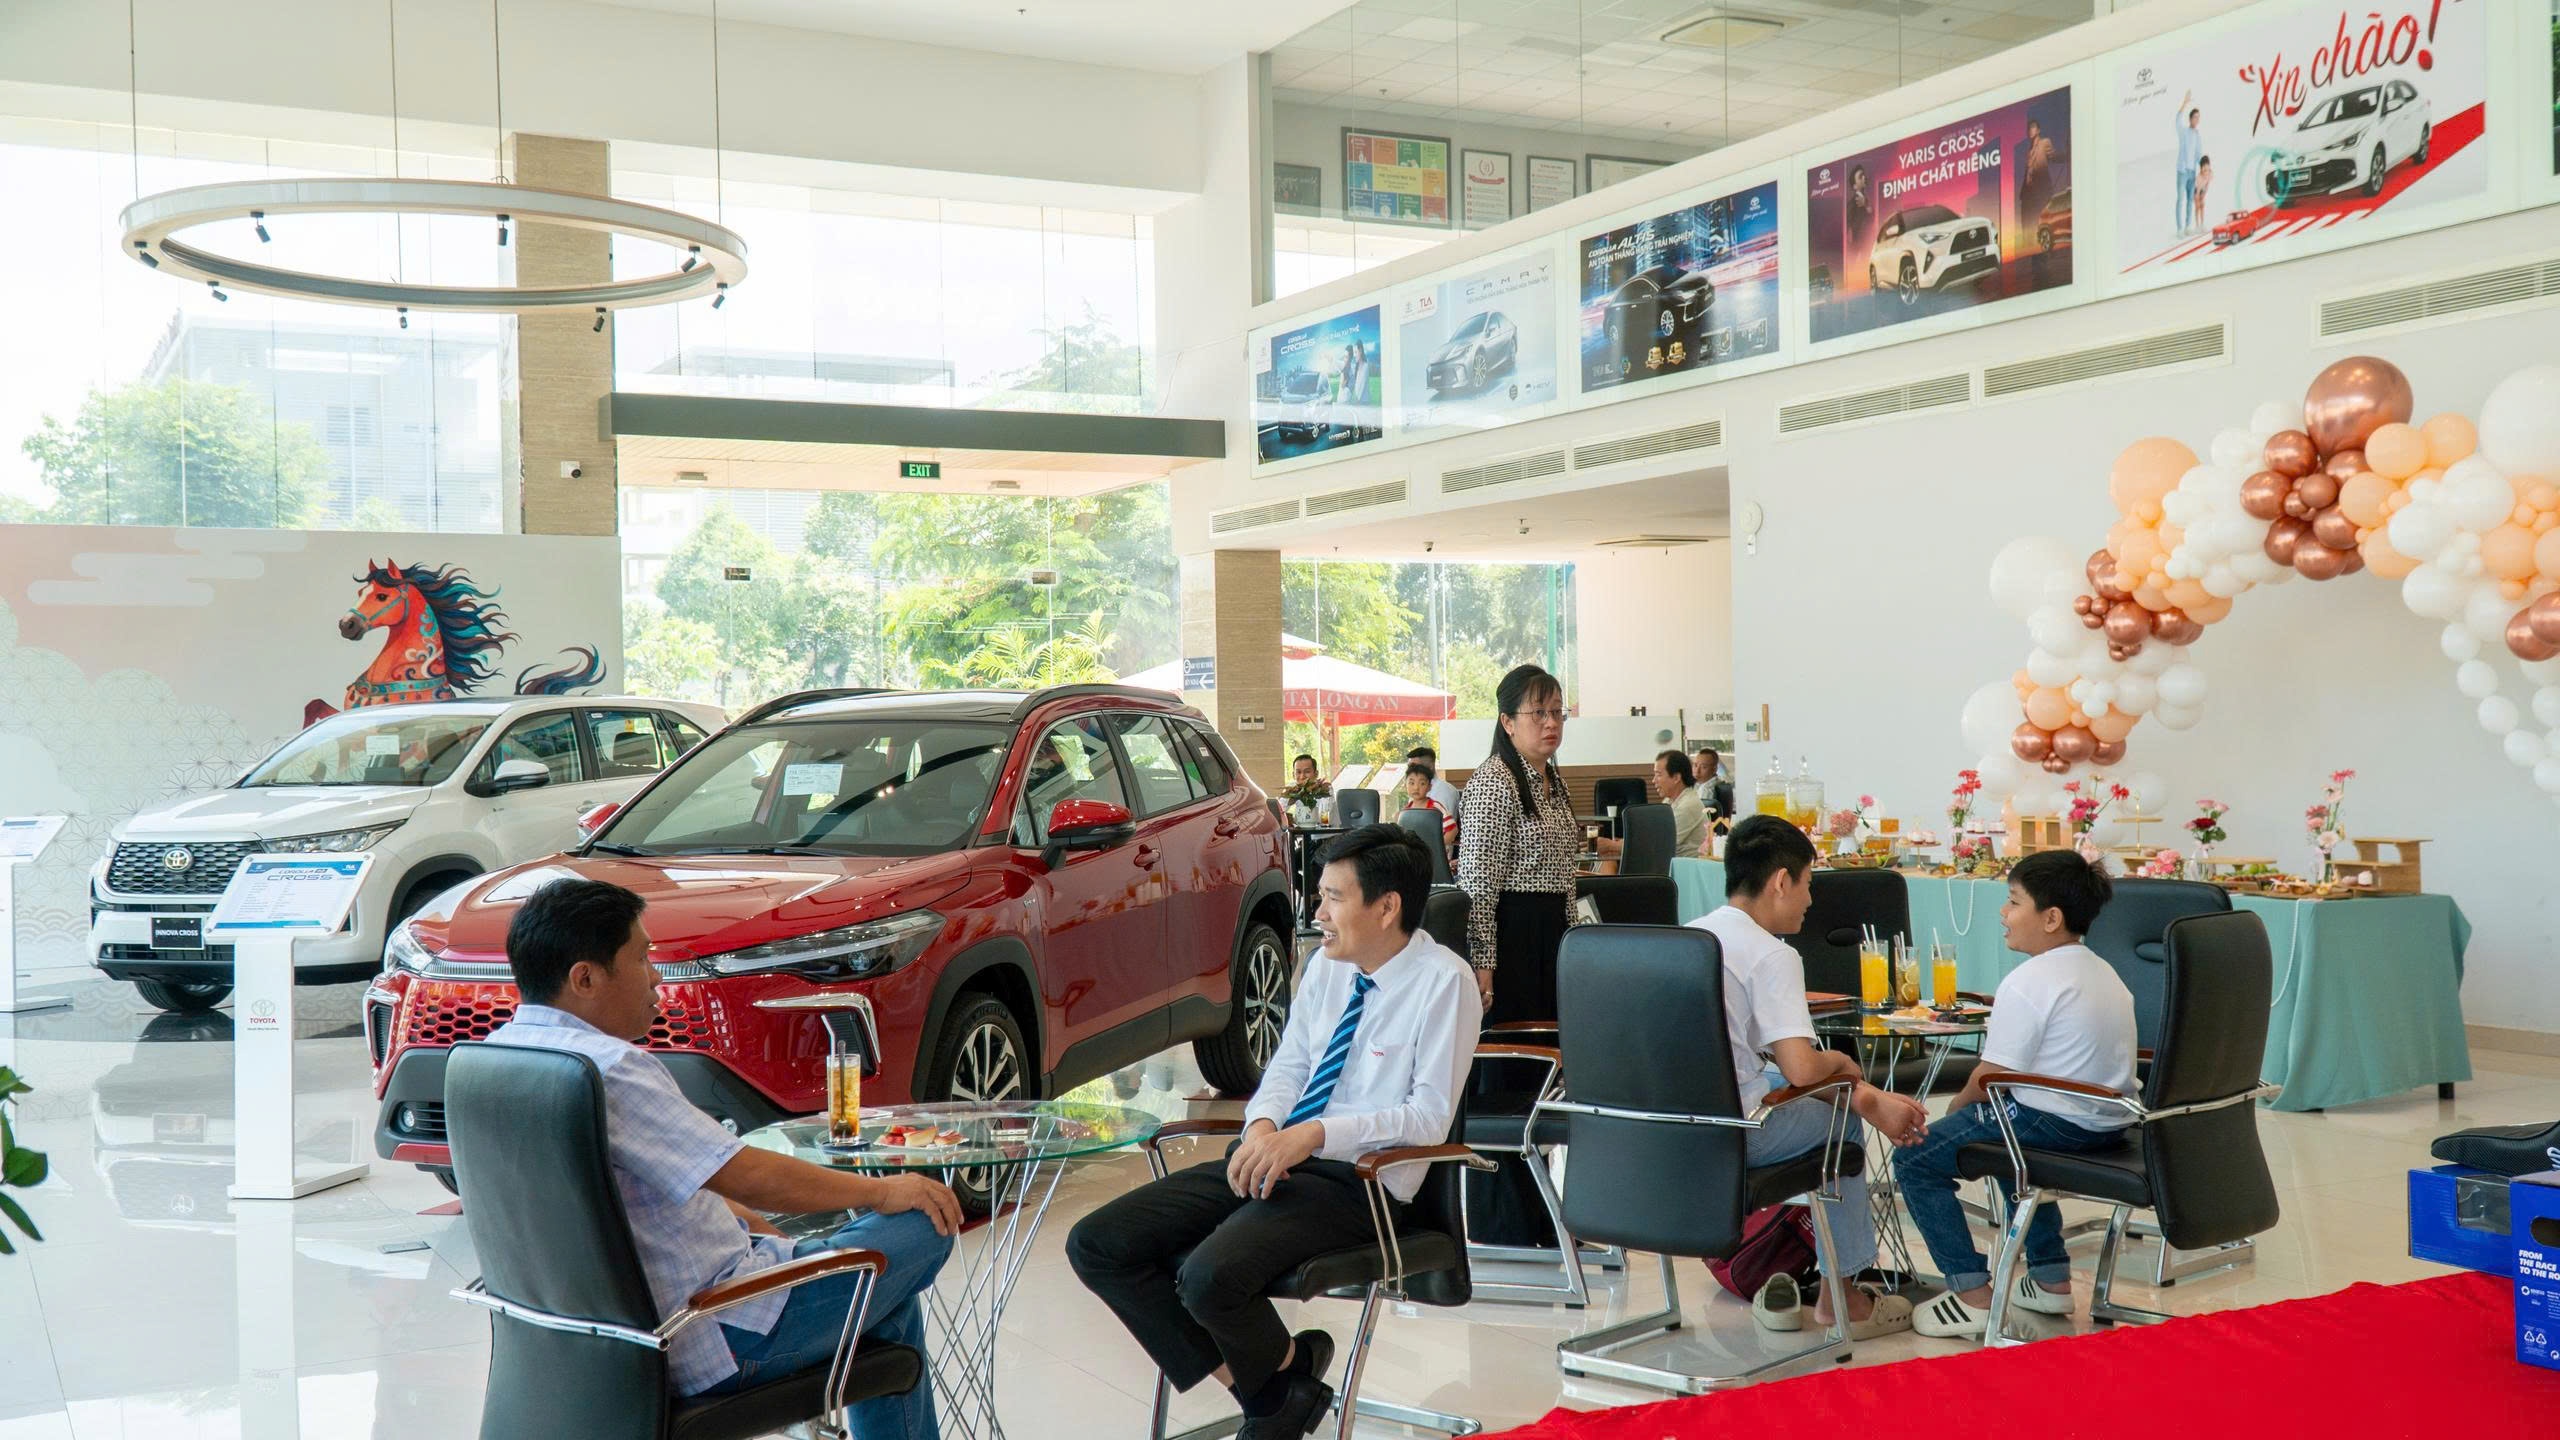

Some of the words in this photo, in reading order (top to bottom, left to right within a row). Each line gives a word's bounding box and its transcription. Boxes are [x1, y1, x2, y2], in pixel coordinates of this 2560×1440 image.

[1899, 145, 1935, 170] YARIS
[1938, 129, 1985, 157] CROSS
[1883, 176, 1917, 199] ĐỊNH
[1919, 159, 1954, 187] CHẤT
[1957, 149, 2001, 177] RIÊNG
[1618, 230, 1655, 249] ALTIS
[1588, 259, 1597, 268] AN
[1280, 337, 1317, 355] CROSS
[909, 463, 931, 477] EXIT
[1317, 693, 1369, 710] LONG
[1373, 697, 1399, 711] AN
[155, 929, 178, 937] INNOVA
[179, 929, 199, 937] CROSS
[2519, 1249, 2543, 1260] FROM
[2520, 1258, 2534, 1267] THE
[2535, 1261, 2557, 1272] RACE
[2520, 1266, 2531, 1275] TO
[2532, 1268, 2547, 1278] THE
